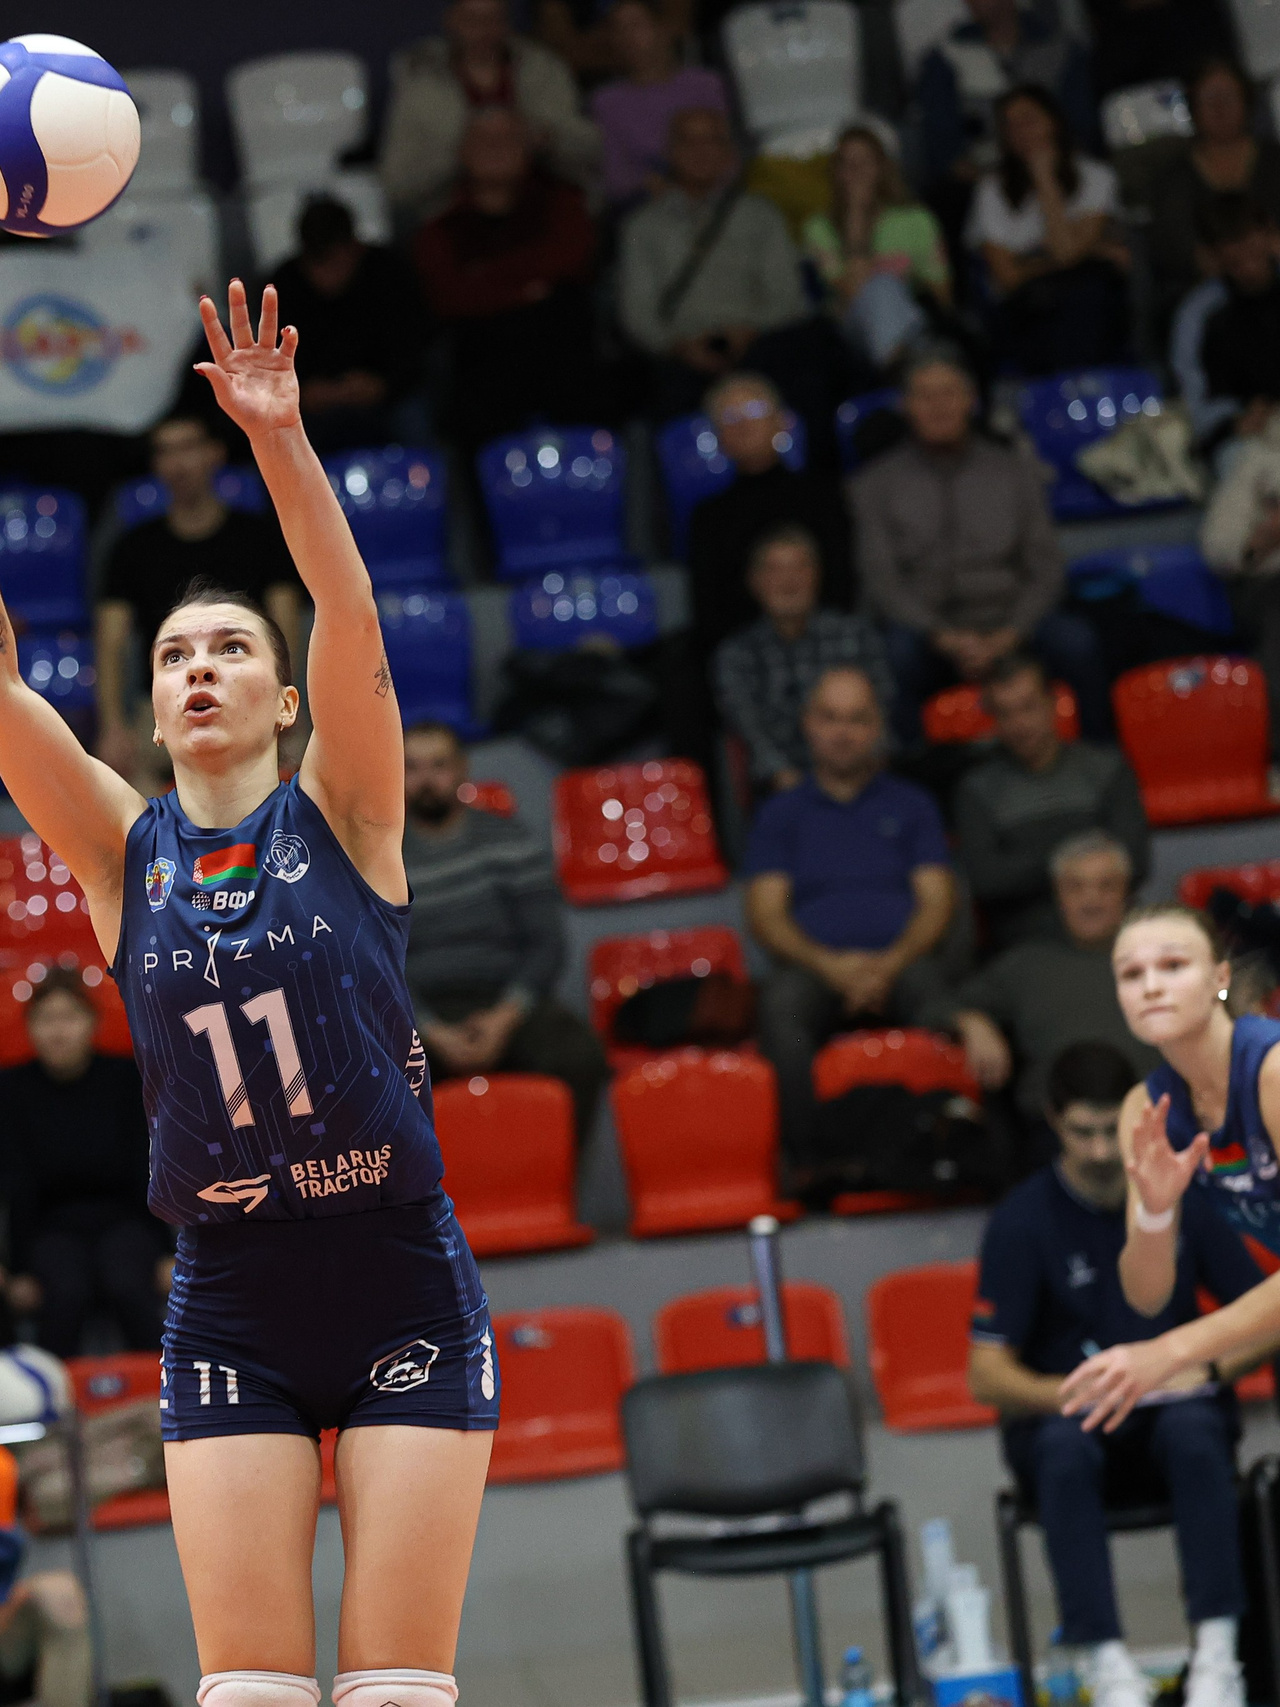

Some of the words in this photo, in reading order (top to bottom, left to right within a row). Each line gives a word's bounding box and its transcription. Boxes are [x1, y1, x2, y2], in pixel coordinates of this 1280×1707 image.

[182, 987, 314, 1130] 11
[290, 1144, 392, 1183] BELARUS
[193, 1361, 239, 1405] 11
